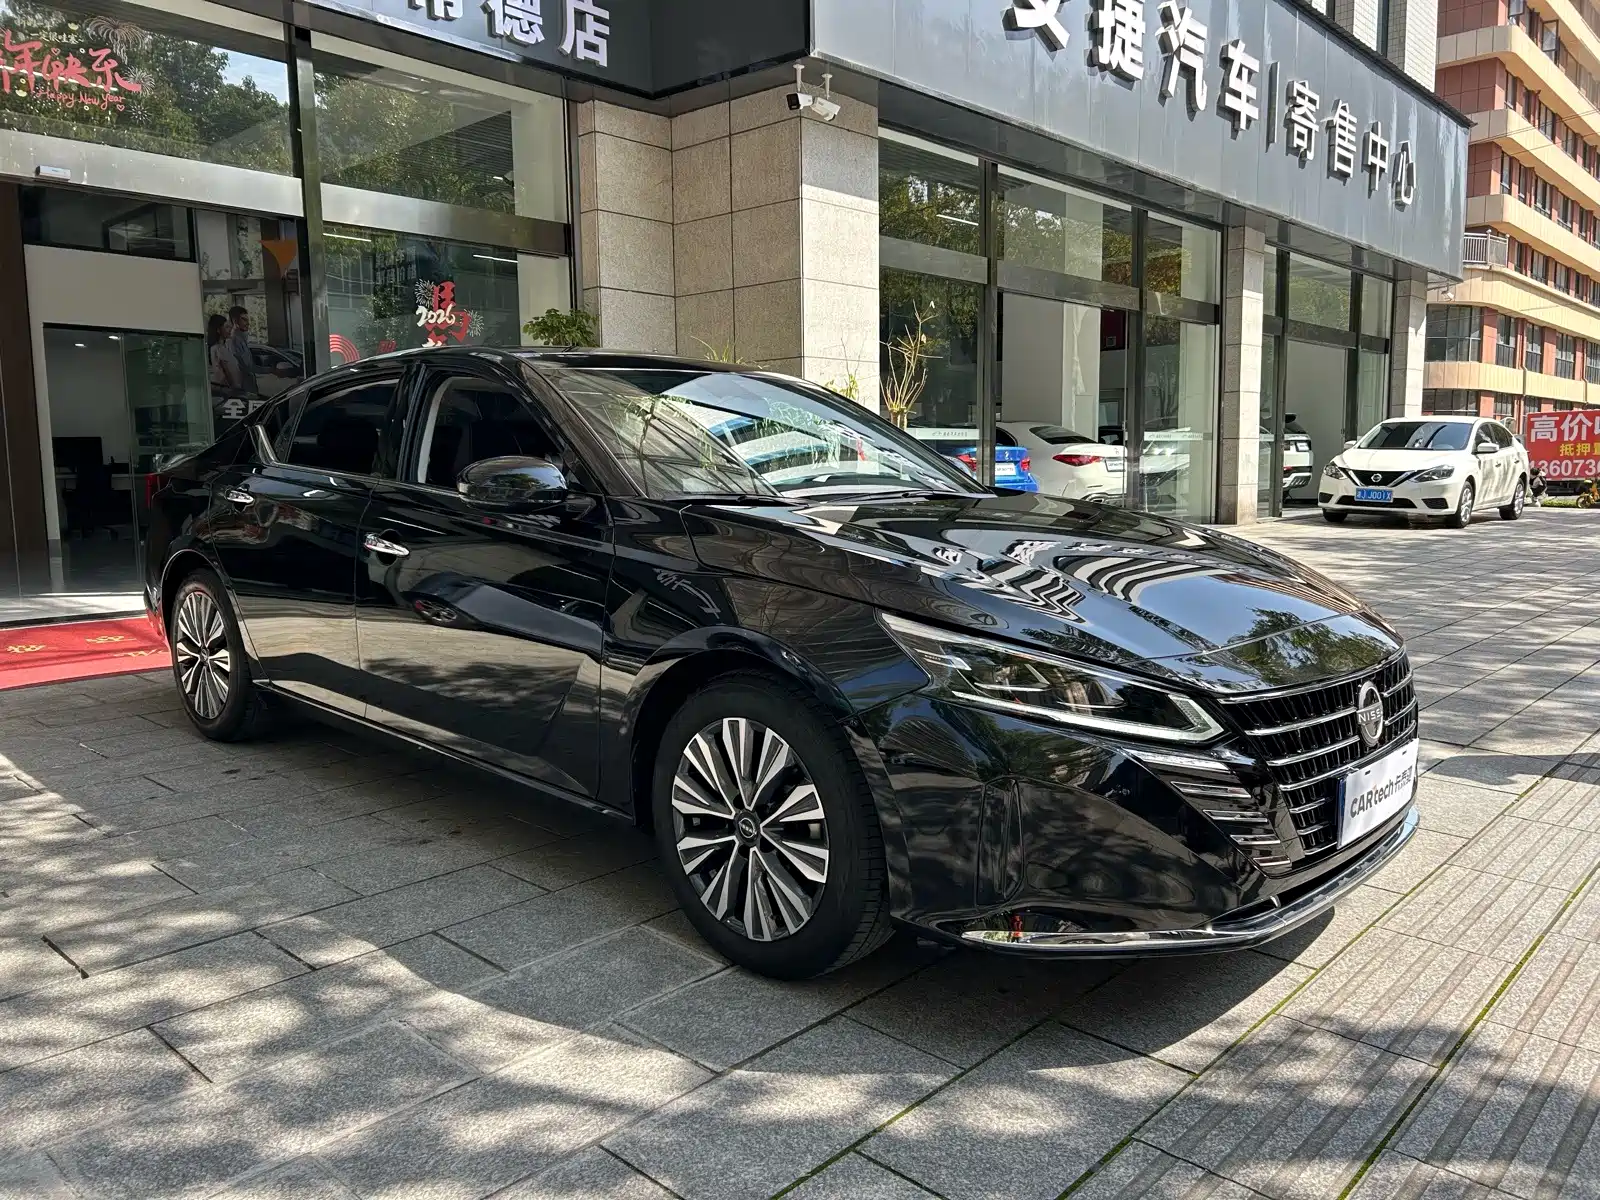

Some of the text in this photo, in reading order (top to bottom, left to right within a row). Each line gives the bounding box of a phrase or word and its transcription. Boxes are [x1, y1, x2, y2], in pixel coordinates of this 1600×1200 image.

[0, 29, 141, 93] 年快乐
[78, 91, 99, 105] New
[416, 303, 456, 327] 2026
[1358, 708, 1383, 723] NISS
